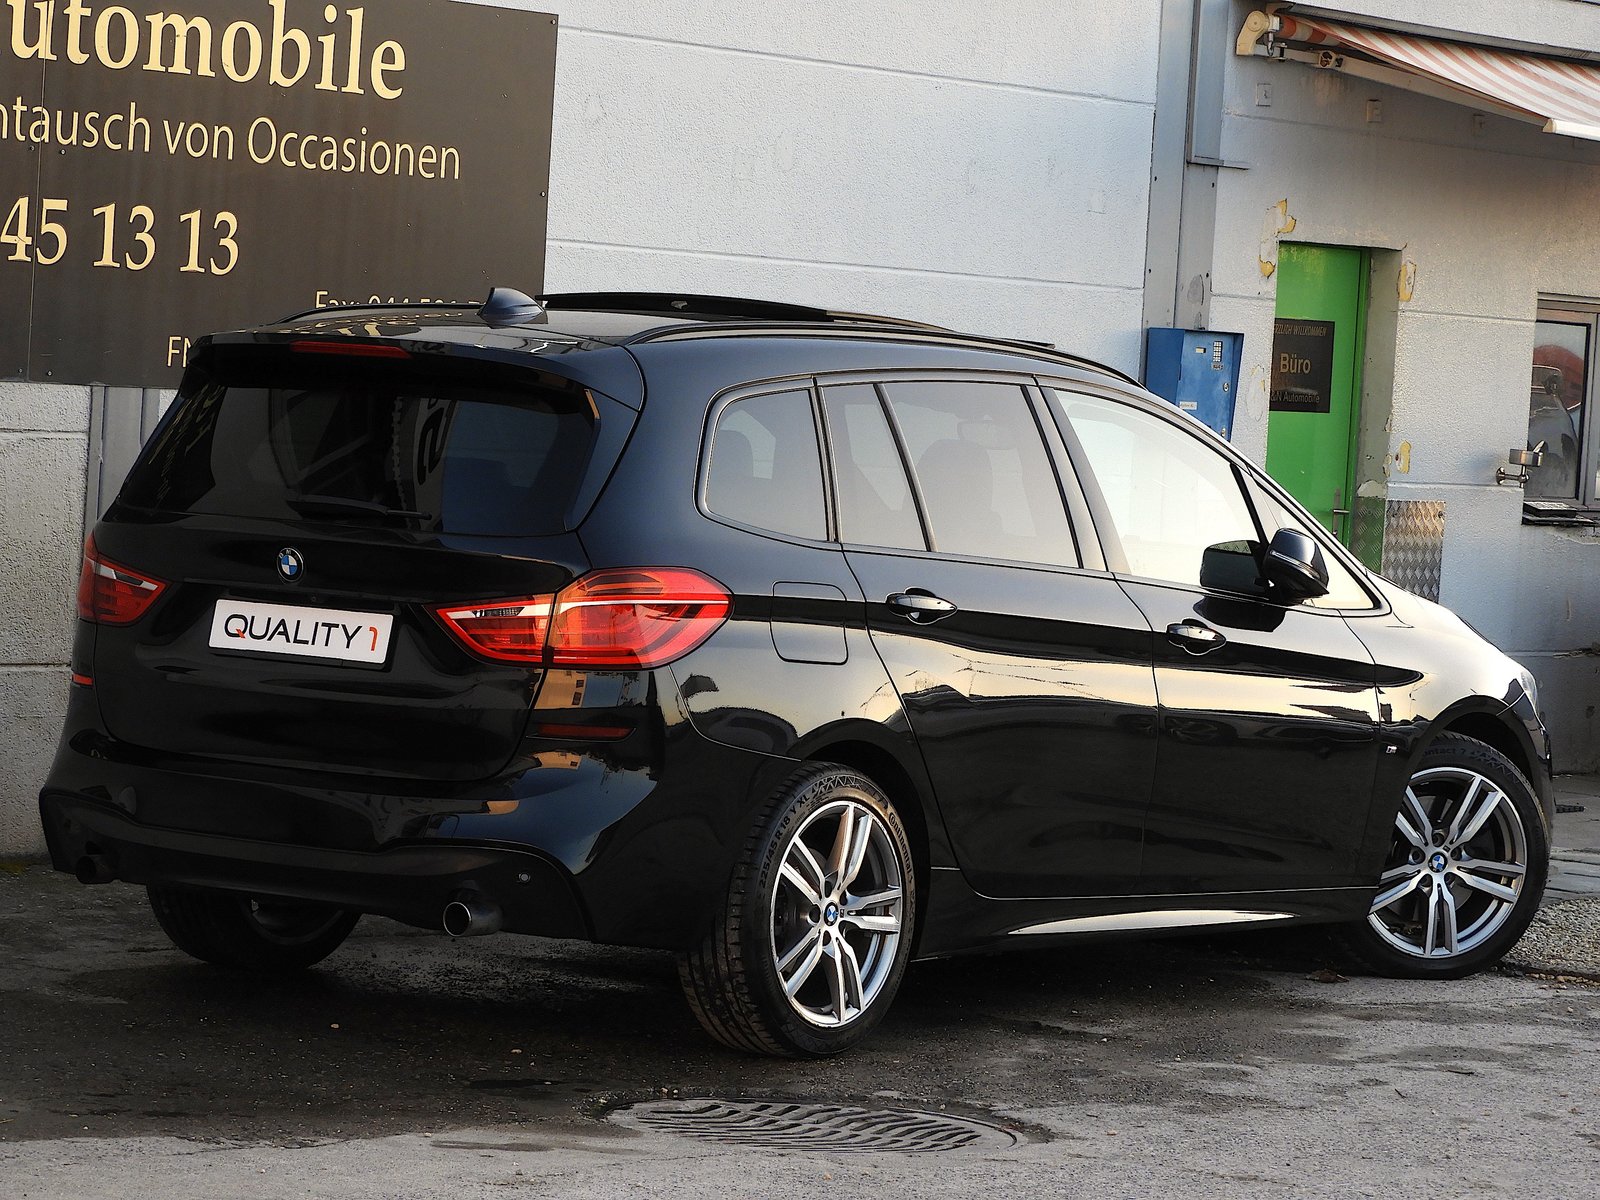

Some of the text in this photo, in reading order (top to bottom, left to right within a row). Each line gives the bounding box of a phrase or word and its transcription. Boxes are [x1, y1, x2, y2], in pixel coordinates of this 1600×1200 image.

[163, 119, 234, 160] von
[248, 117, 461, 180] Occasionen
[0, 197, 240, 276] 45 13 13
[1279, 353, 1311, 374] Büro
[224, 613, 378, 652] QUALITY 1
